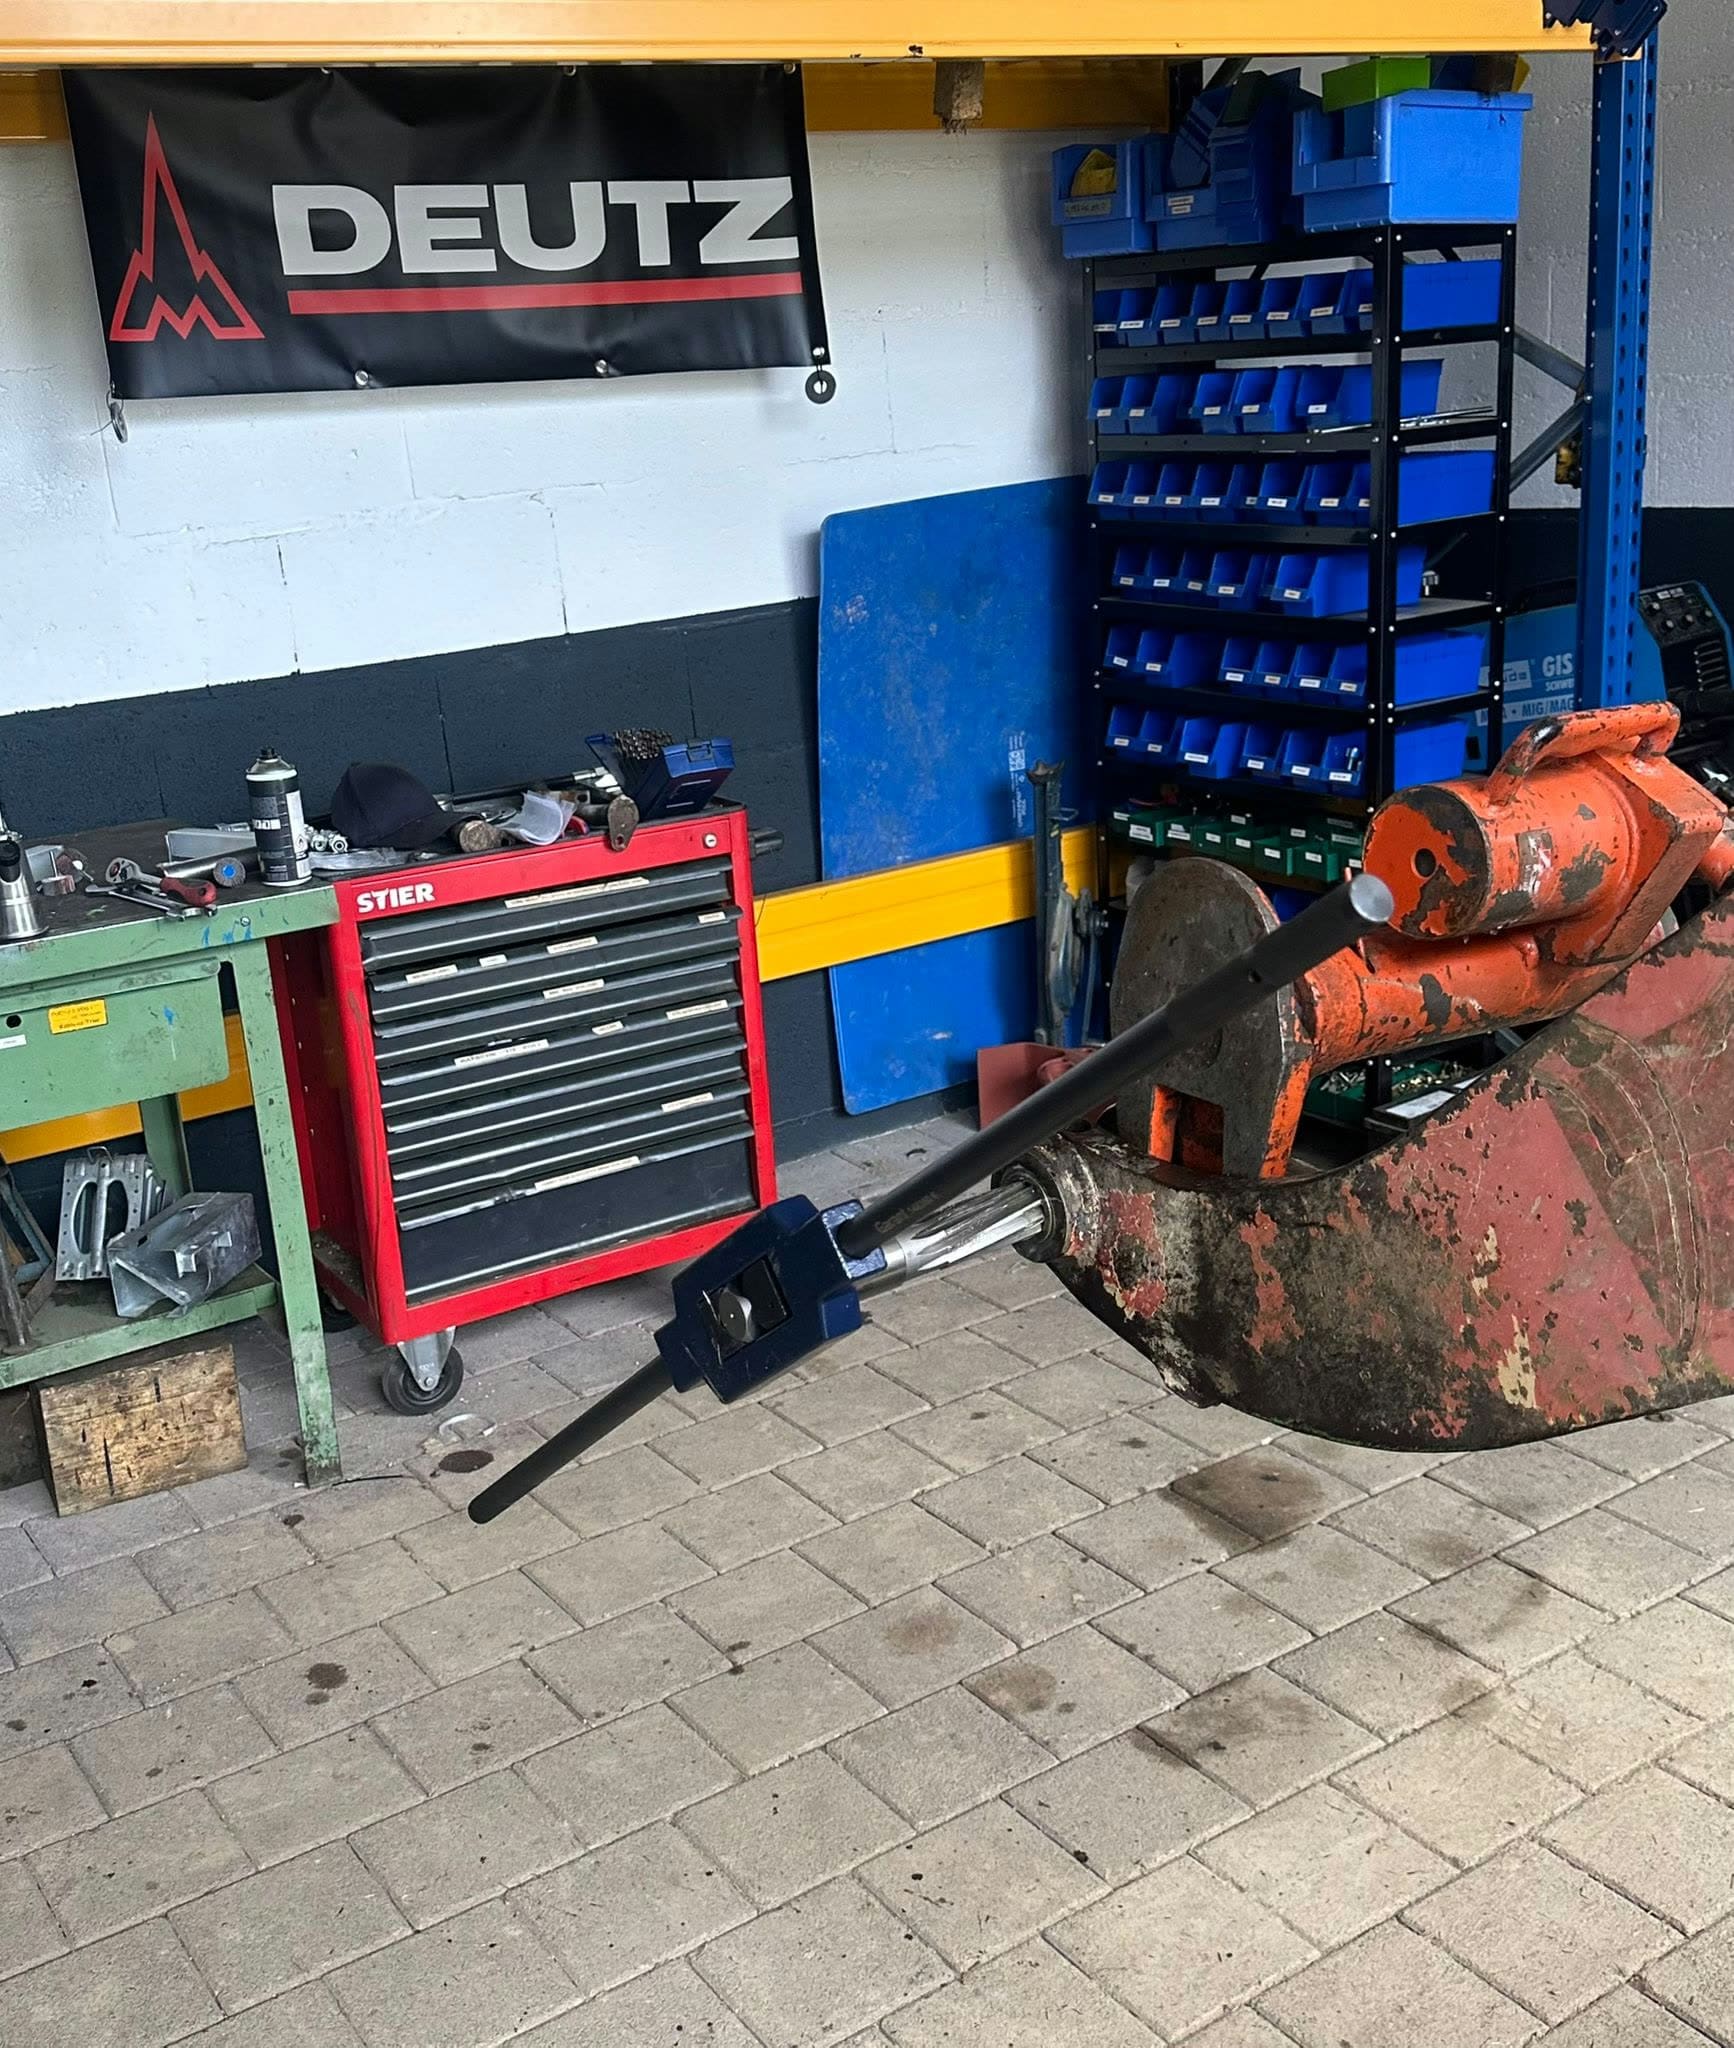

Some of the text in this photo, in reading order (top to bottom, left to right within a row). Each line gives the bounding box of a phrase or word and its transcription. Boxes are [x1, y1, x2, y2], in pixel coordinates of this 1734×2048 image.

[272, 176, 799, 276] DEUTZ
[1542, 653, 1573, 677] GIS
[356, 883, 435, 914] STIER
